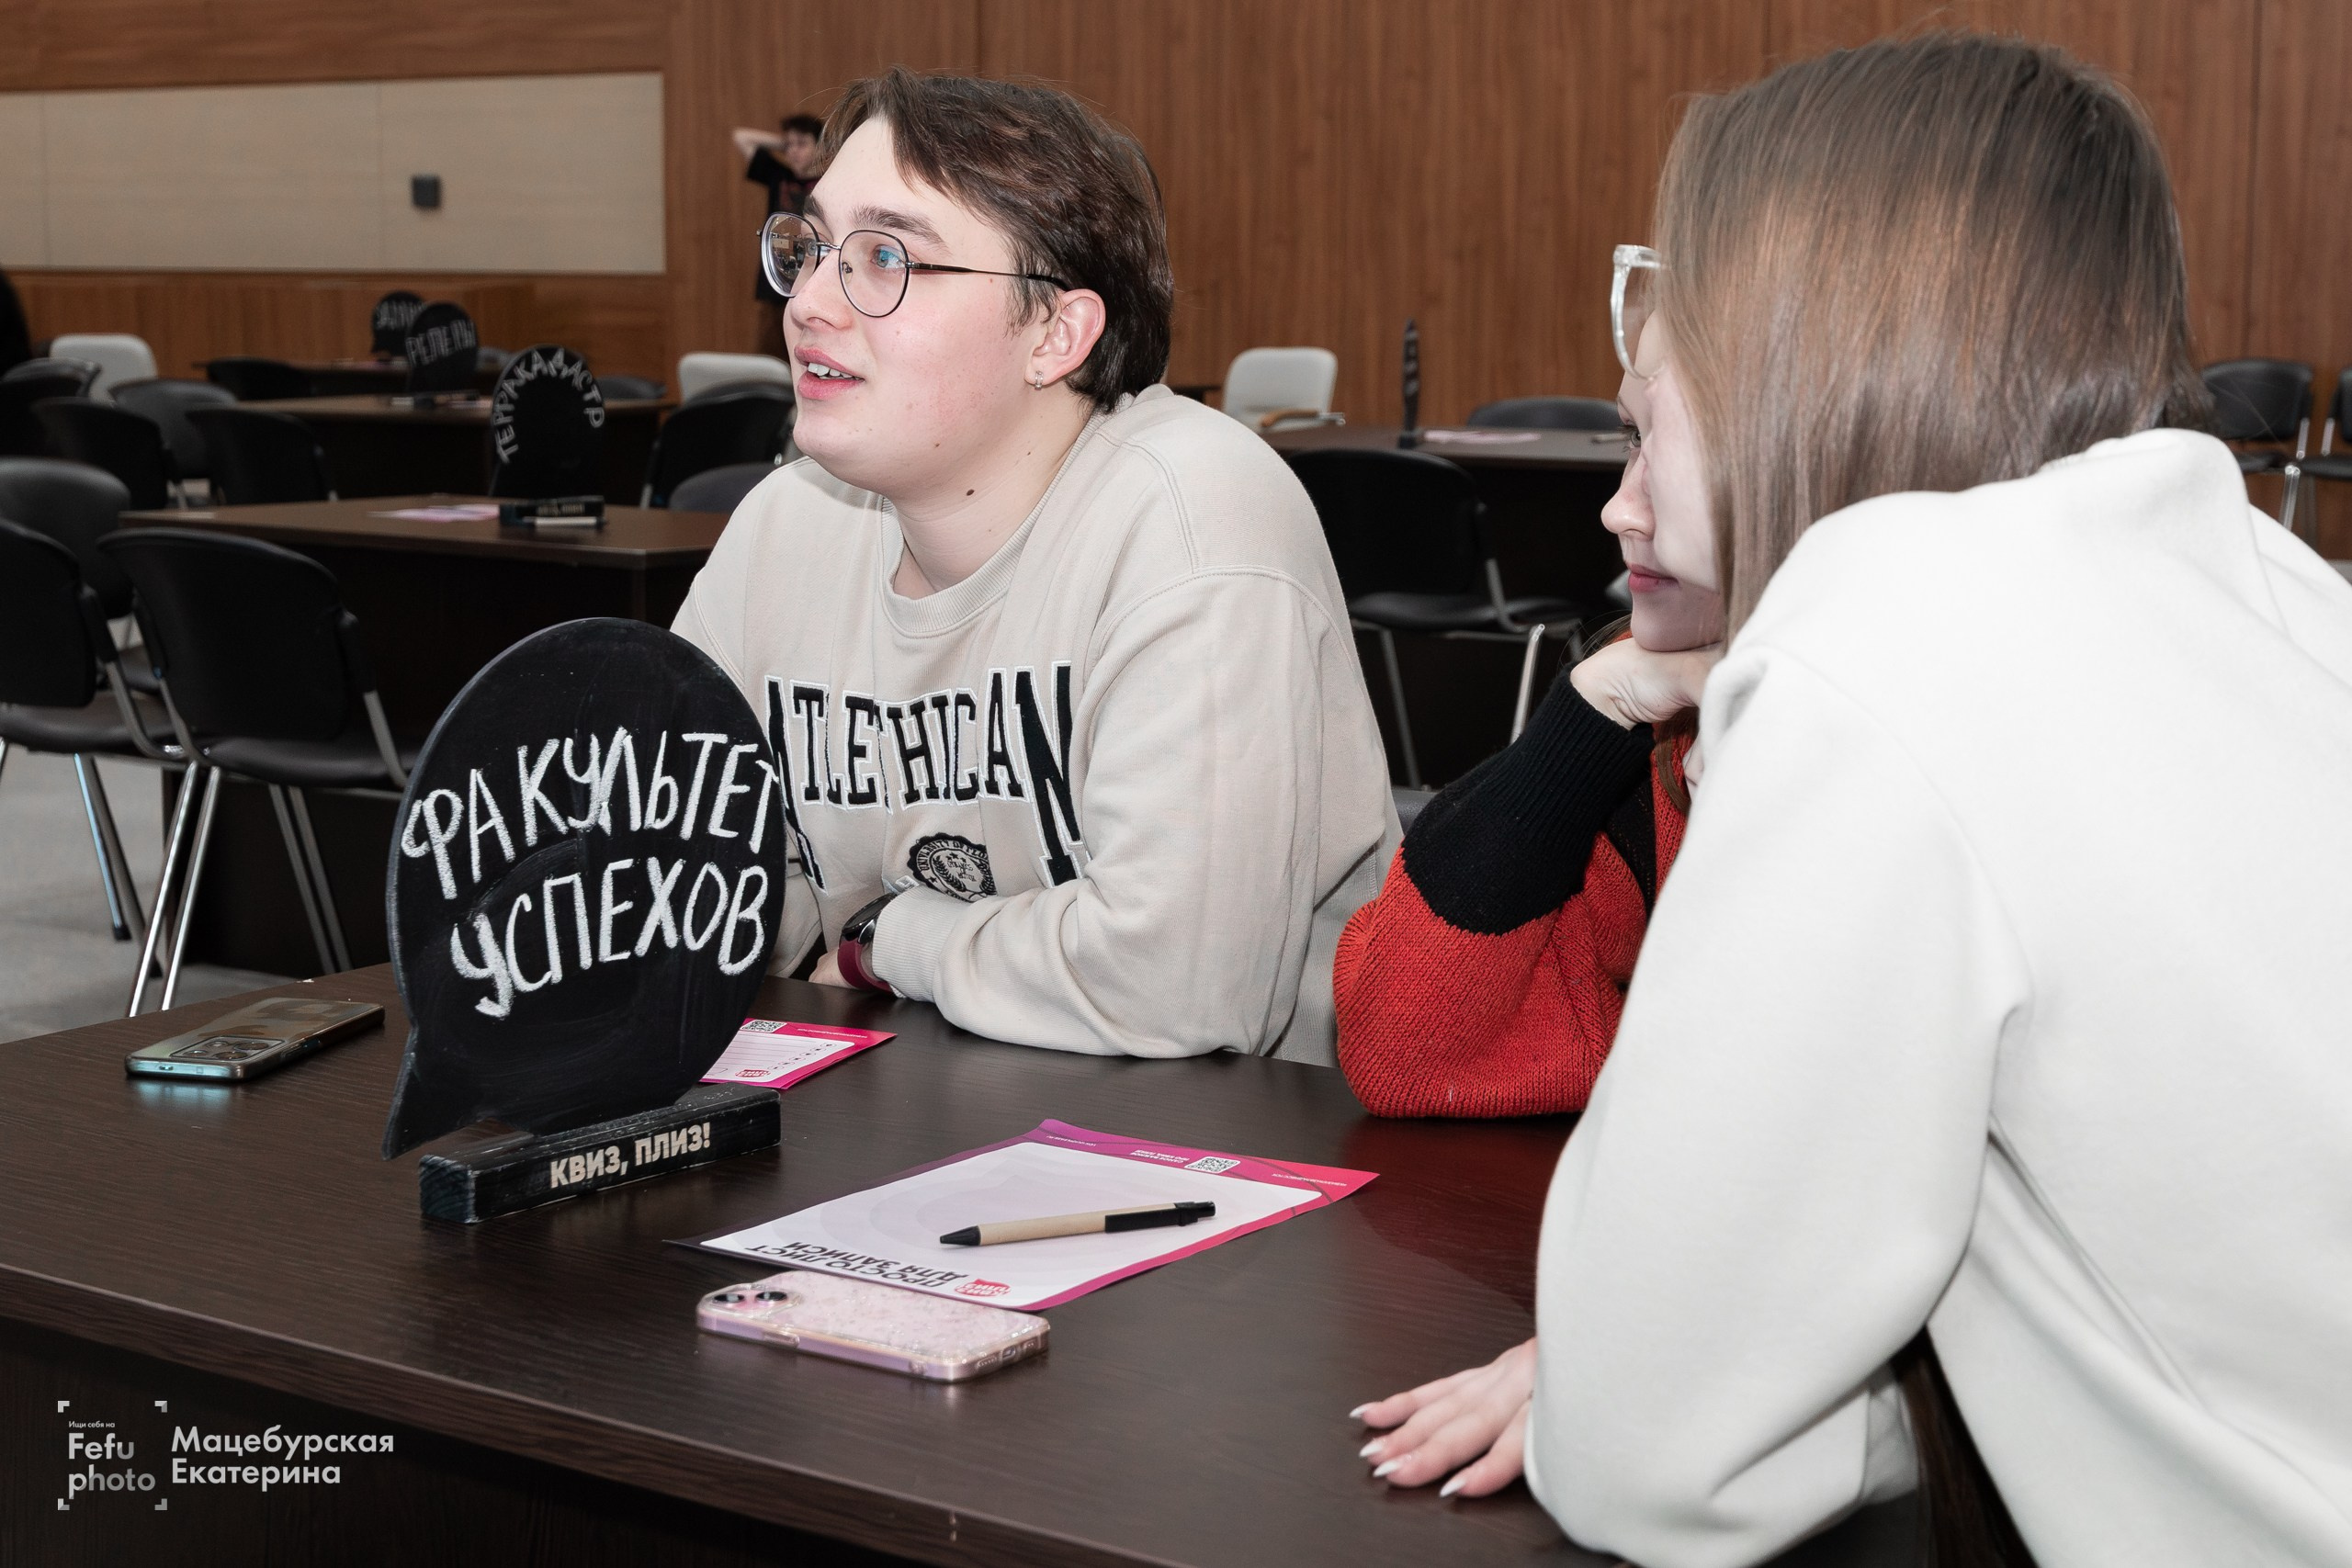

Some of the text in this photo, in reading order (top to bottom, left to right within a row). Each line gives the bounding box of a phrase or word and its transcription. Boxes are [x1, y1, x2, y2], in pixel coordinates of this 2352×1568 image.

[401, 726, 779, 900] ФАКУЛЬТЕТ
[764, 660, 1091, 896] TLEHICAN
[450, 856, 768, 1021] УСПЕХОВ
[550, 1122, 711, 1190] КВИЗ, ПЛИЗ!
[745, 1245, 946, 1288] ПРОСТО ЛИСТ
[785, 1241, 969, 1282] ДЛЯ ЗАПИСИ
